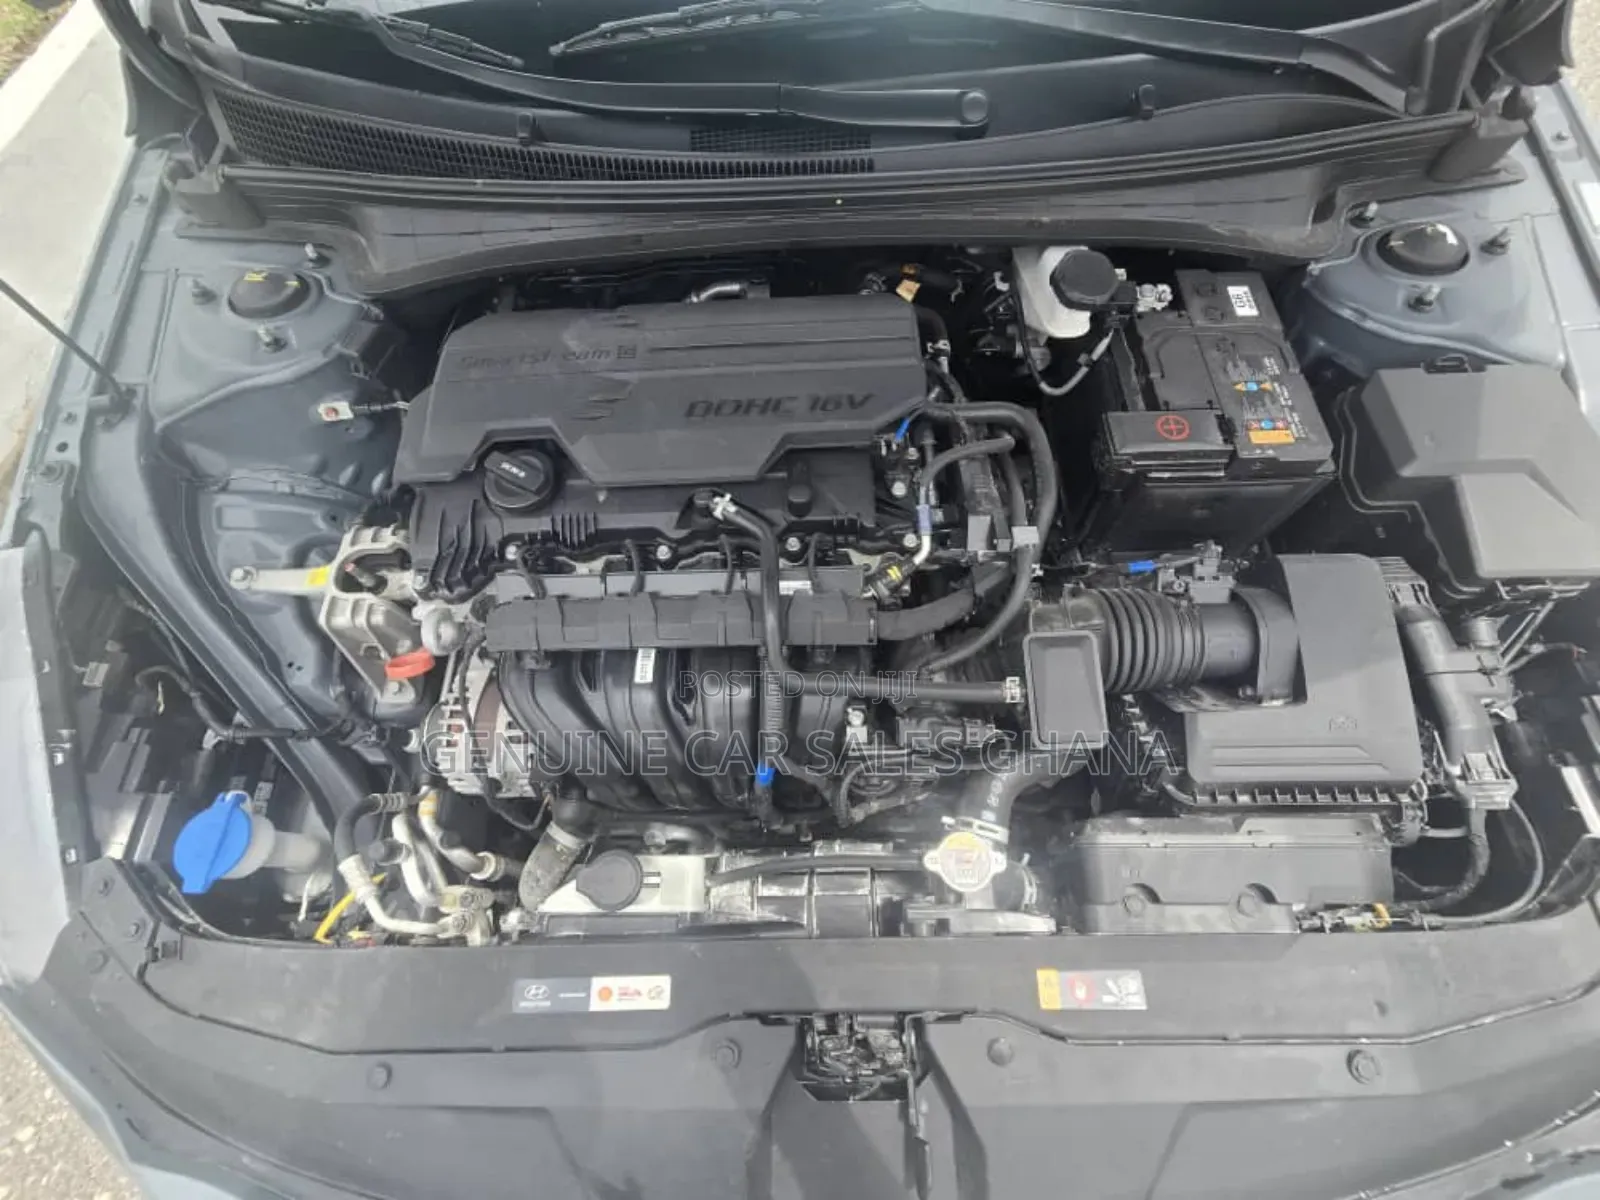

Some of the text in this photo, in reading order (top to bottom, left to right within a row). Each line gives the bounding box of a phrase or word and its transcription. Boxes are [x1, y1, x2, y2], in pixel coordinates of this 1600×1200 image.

[460, 348, 611, 369] Smartsteam
[685, 392, 875, 418] DOHC 16V
